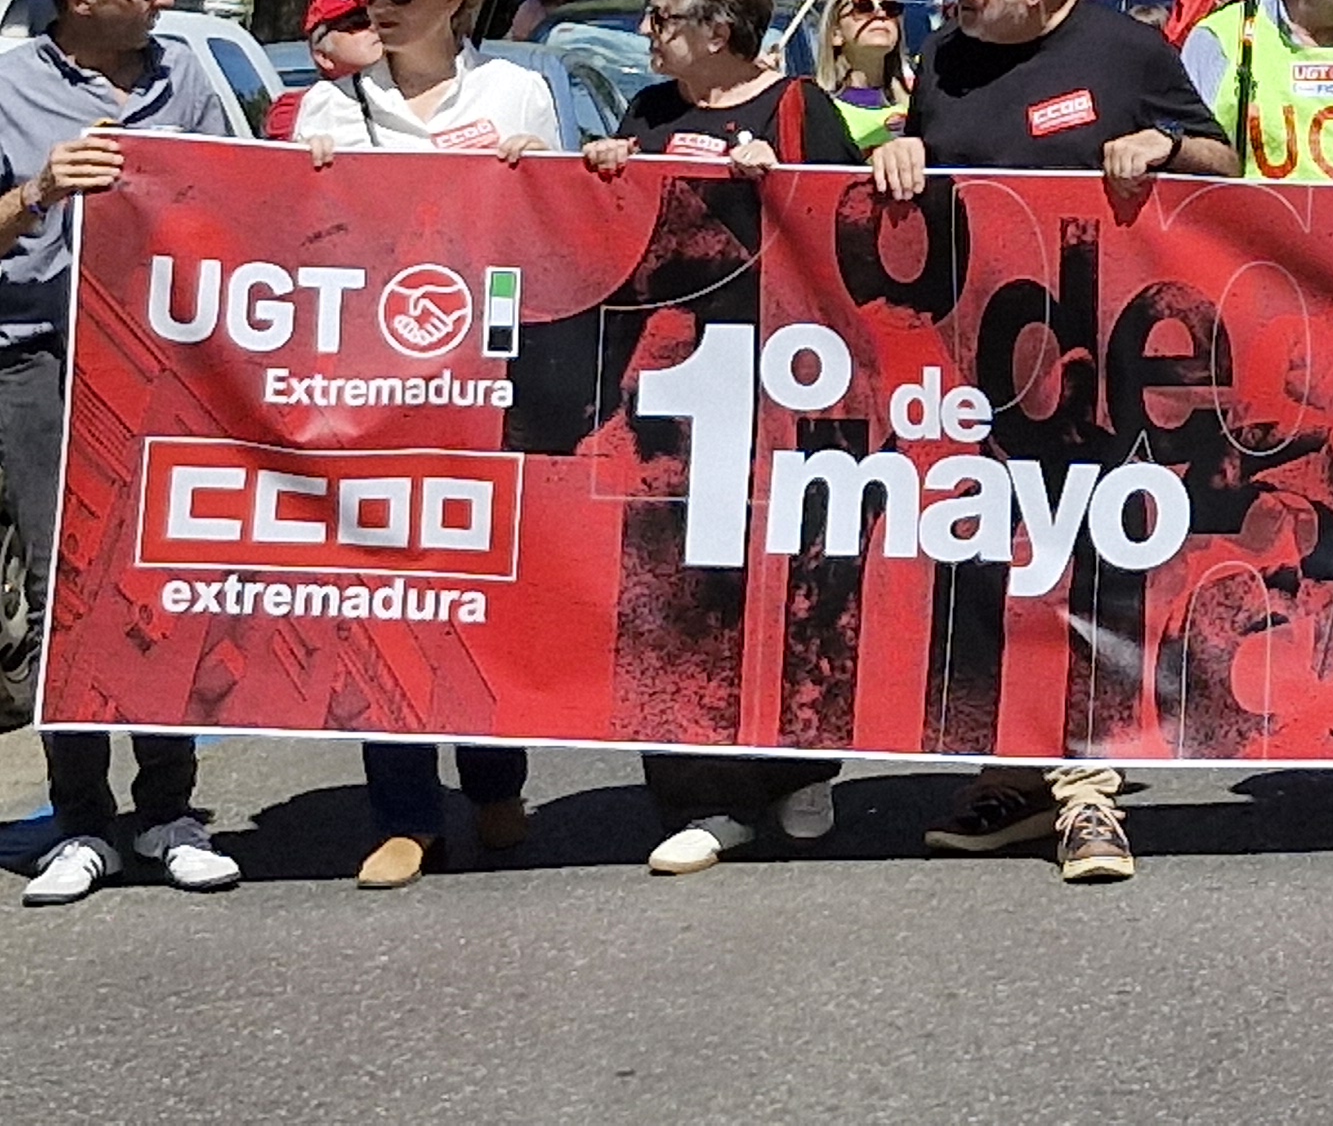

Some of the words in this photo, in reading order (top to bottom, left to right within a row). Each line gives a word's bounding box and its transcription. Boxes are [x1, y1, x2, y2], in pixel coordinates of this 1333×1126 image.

[1294, 66, 1330, 79] UGT
[148, 256, 365, 354] UGT
[263, 368, 514, 409] Extremadura
[636, 323, 852, 568] 1º
[890, 366, 993, 443] de
[167, 466, 494, 552] CCOO
[765, 431, 1191, 599] mayo
[162, 573, 486, 623] extremadura
